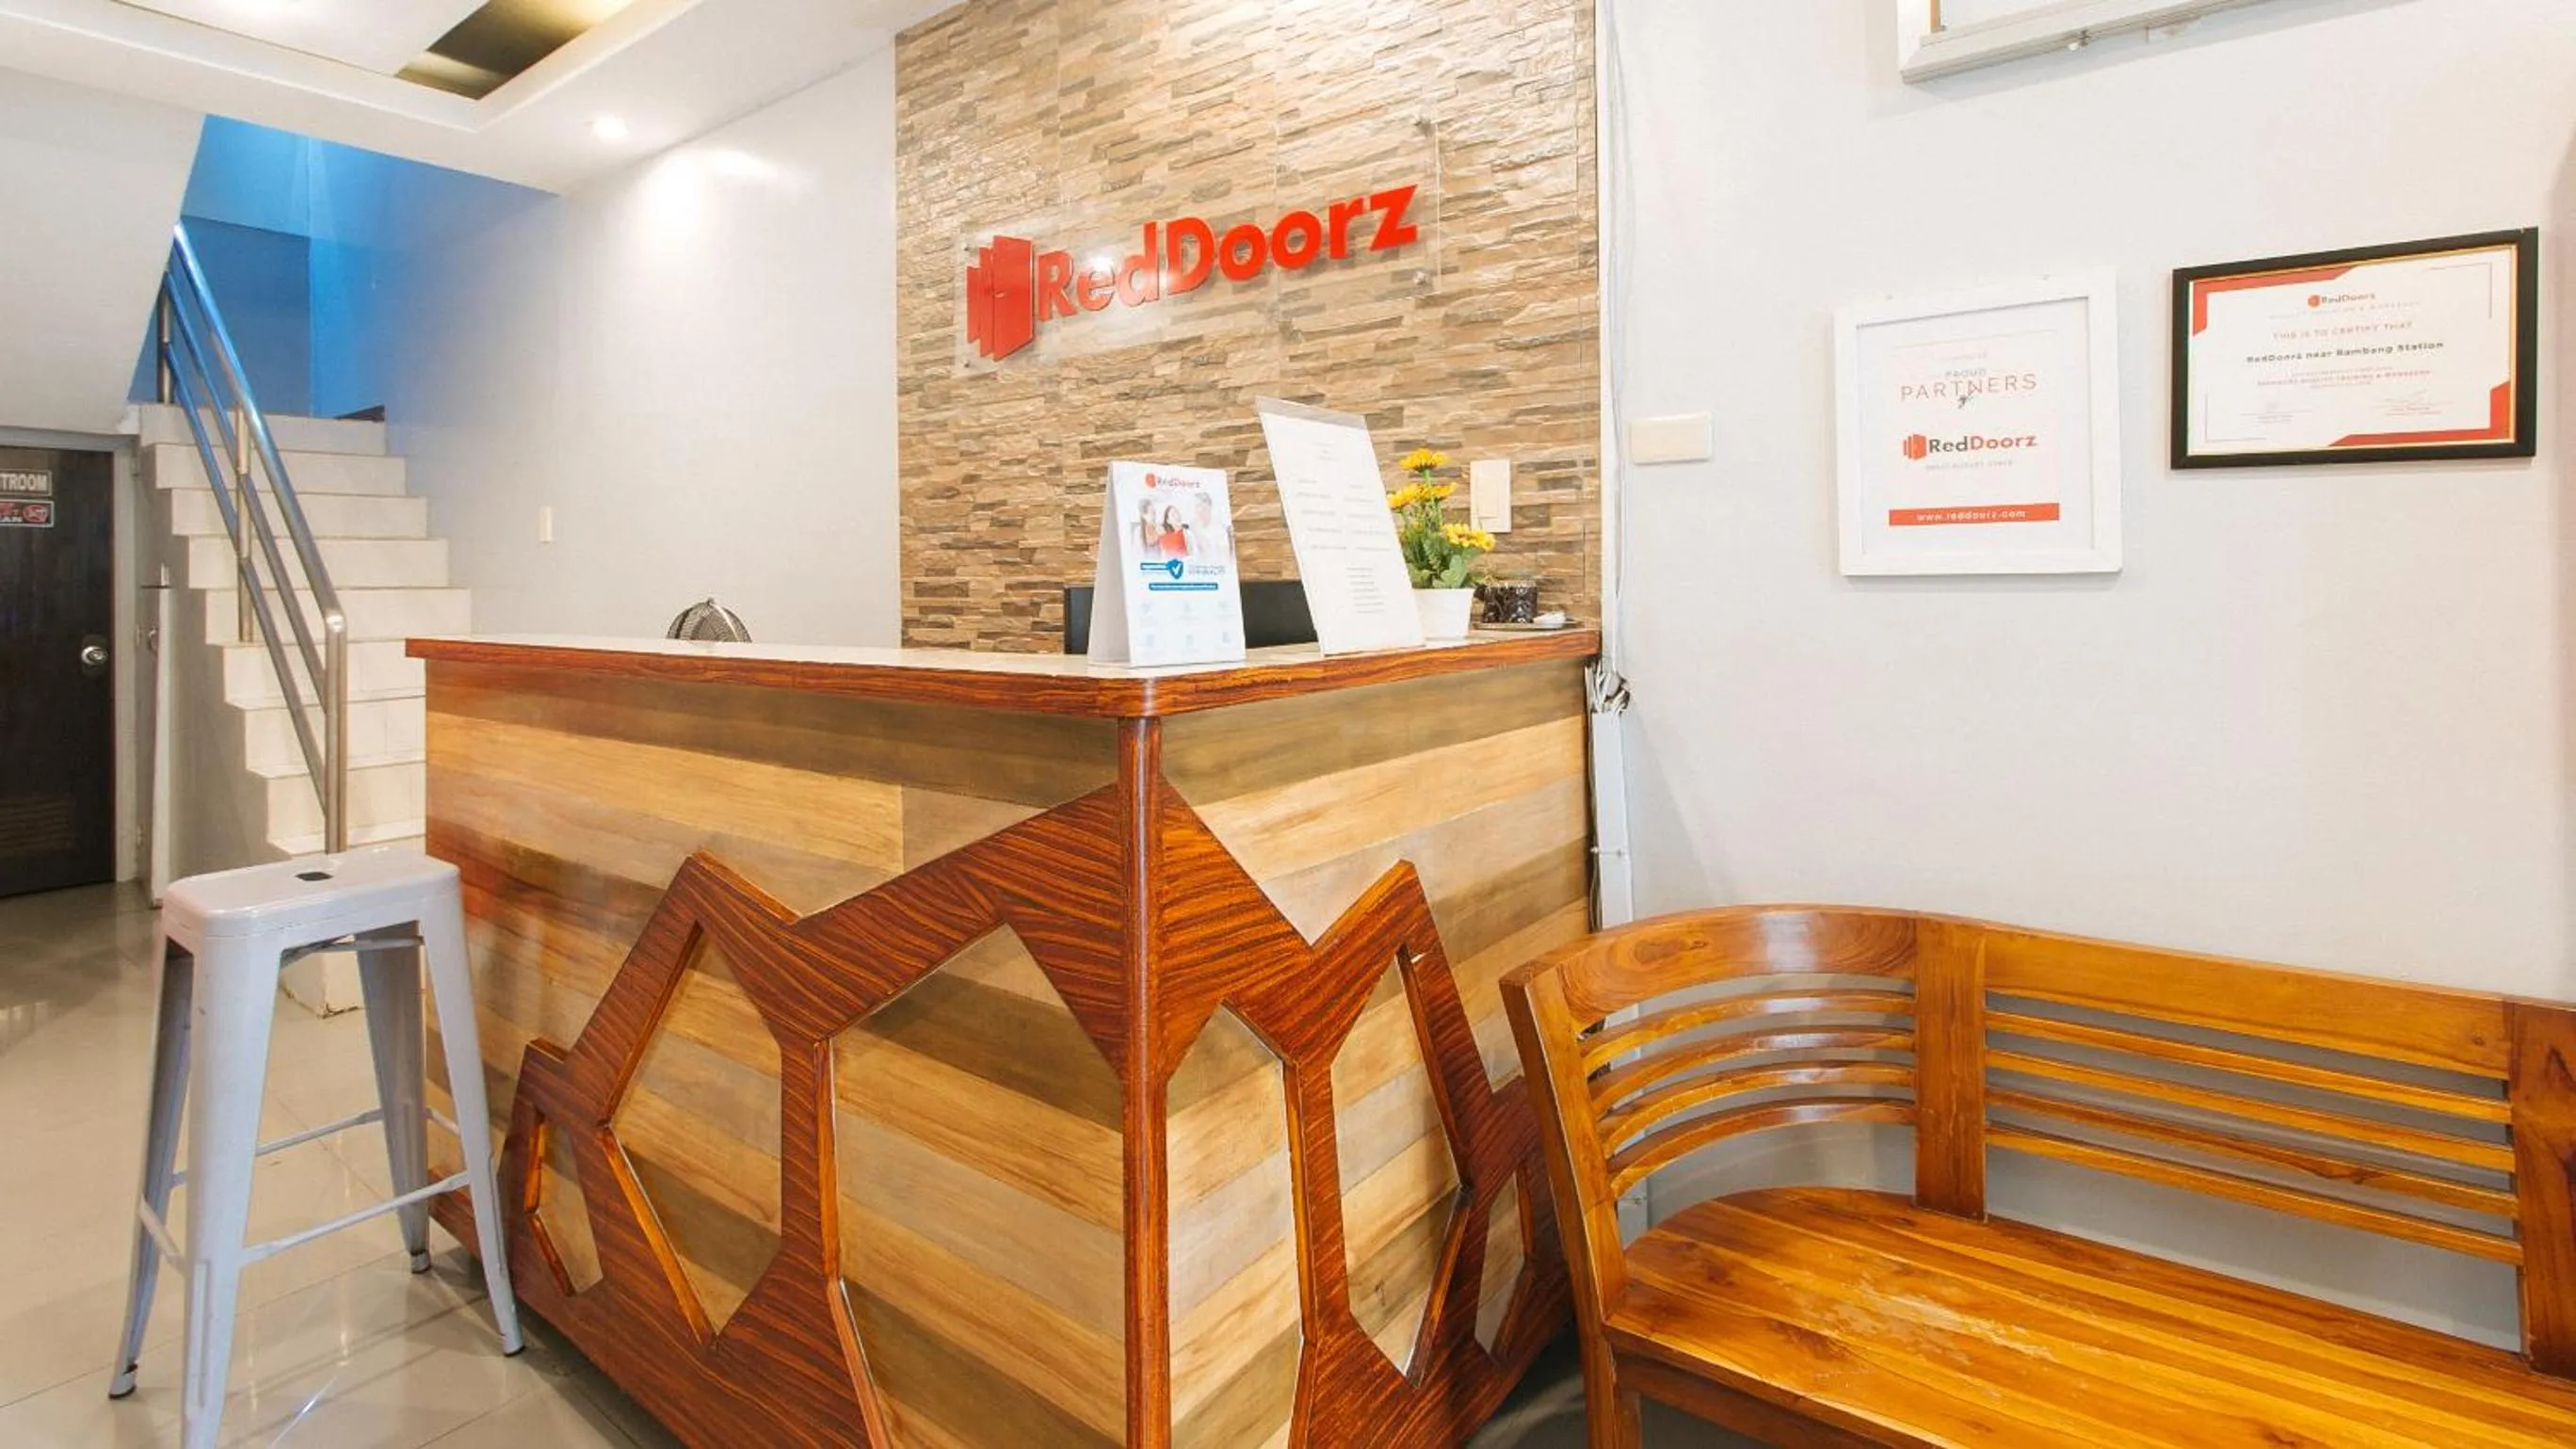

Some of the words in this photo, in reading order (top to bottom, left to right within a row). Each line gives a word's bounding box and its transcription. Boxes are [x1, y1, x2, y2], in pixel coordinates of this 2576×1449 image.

[1037, 184, 1419, 323] RedDoorz
[2305, 350, 2334, 360] near
[2396, 341, 2445, 353] Station
[1901, 374, 2037, 401] PARTNERS
[1928, 434, 2039, 454] RedDoorz
[1916, 510, 2026, 523] www.reddoorz.com
